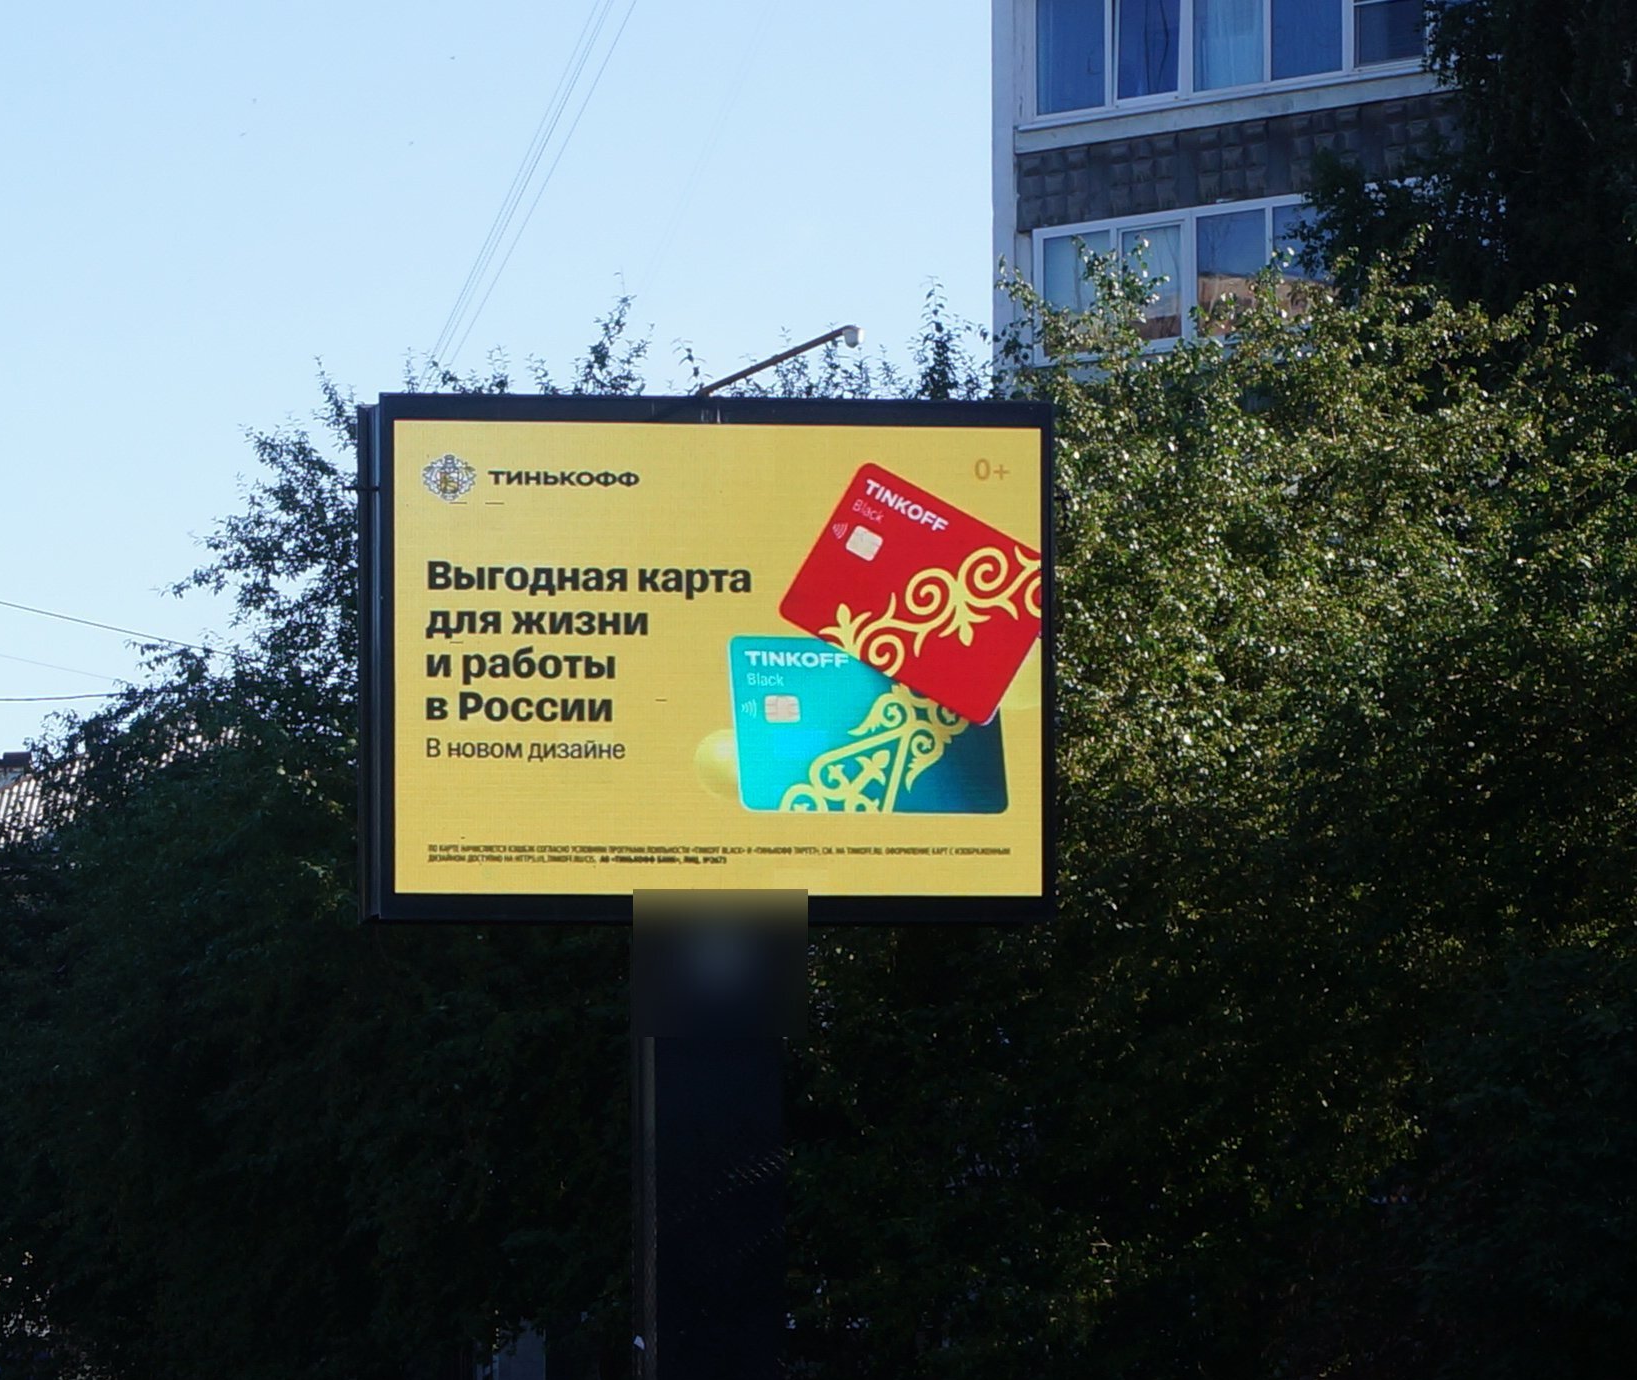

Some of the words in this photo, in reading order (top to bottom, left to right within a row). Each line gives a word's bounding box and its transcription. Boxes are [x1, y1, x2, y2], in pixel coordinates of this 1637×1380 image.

[488, 470, 640, 487] ТИНЬКОФФ
[974, 459, 1011, 481] 0+
[851, 499, 883, 524] Black
[865, 478, 949, 532] TINKOFF
[427, 560, 628, 596] Выгодная
[637, 567, 752, 600] карта
[425, 610, 502, 639] для
[512, 610, 649, 636] жизни
[426, 653, 451, 678] и
[462, 646, 617, 685] работы
[744, 650, 850, 669] TINKOFF
[746, 673, 784, 687] Black
[426, 697, 449, 722] в
[458, 691, 613, 723] России
[426, 738, 441, 758] В
[448, 741, 523, 759] новом
[527, 739, 626, 763] дизайне
